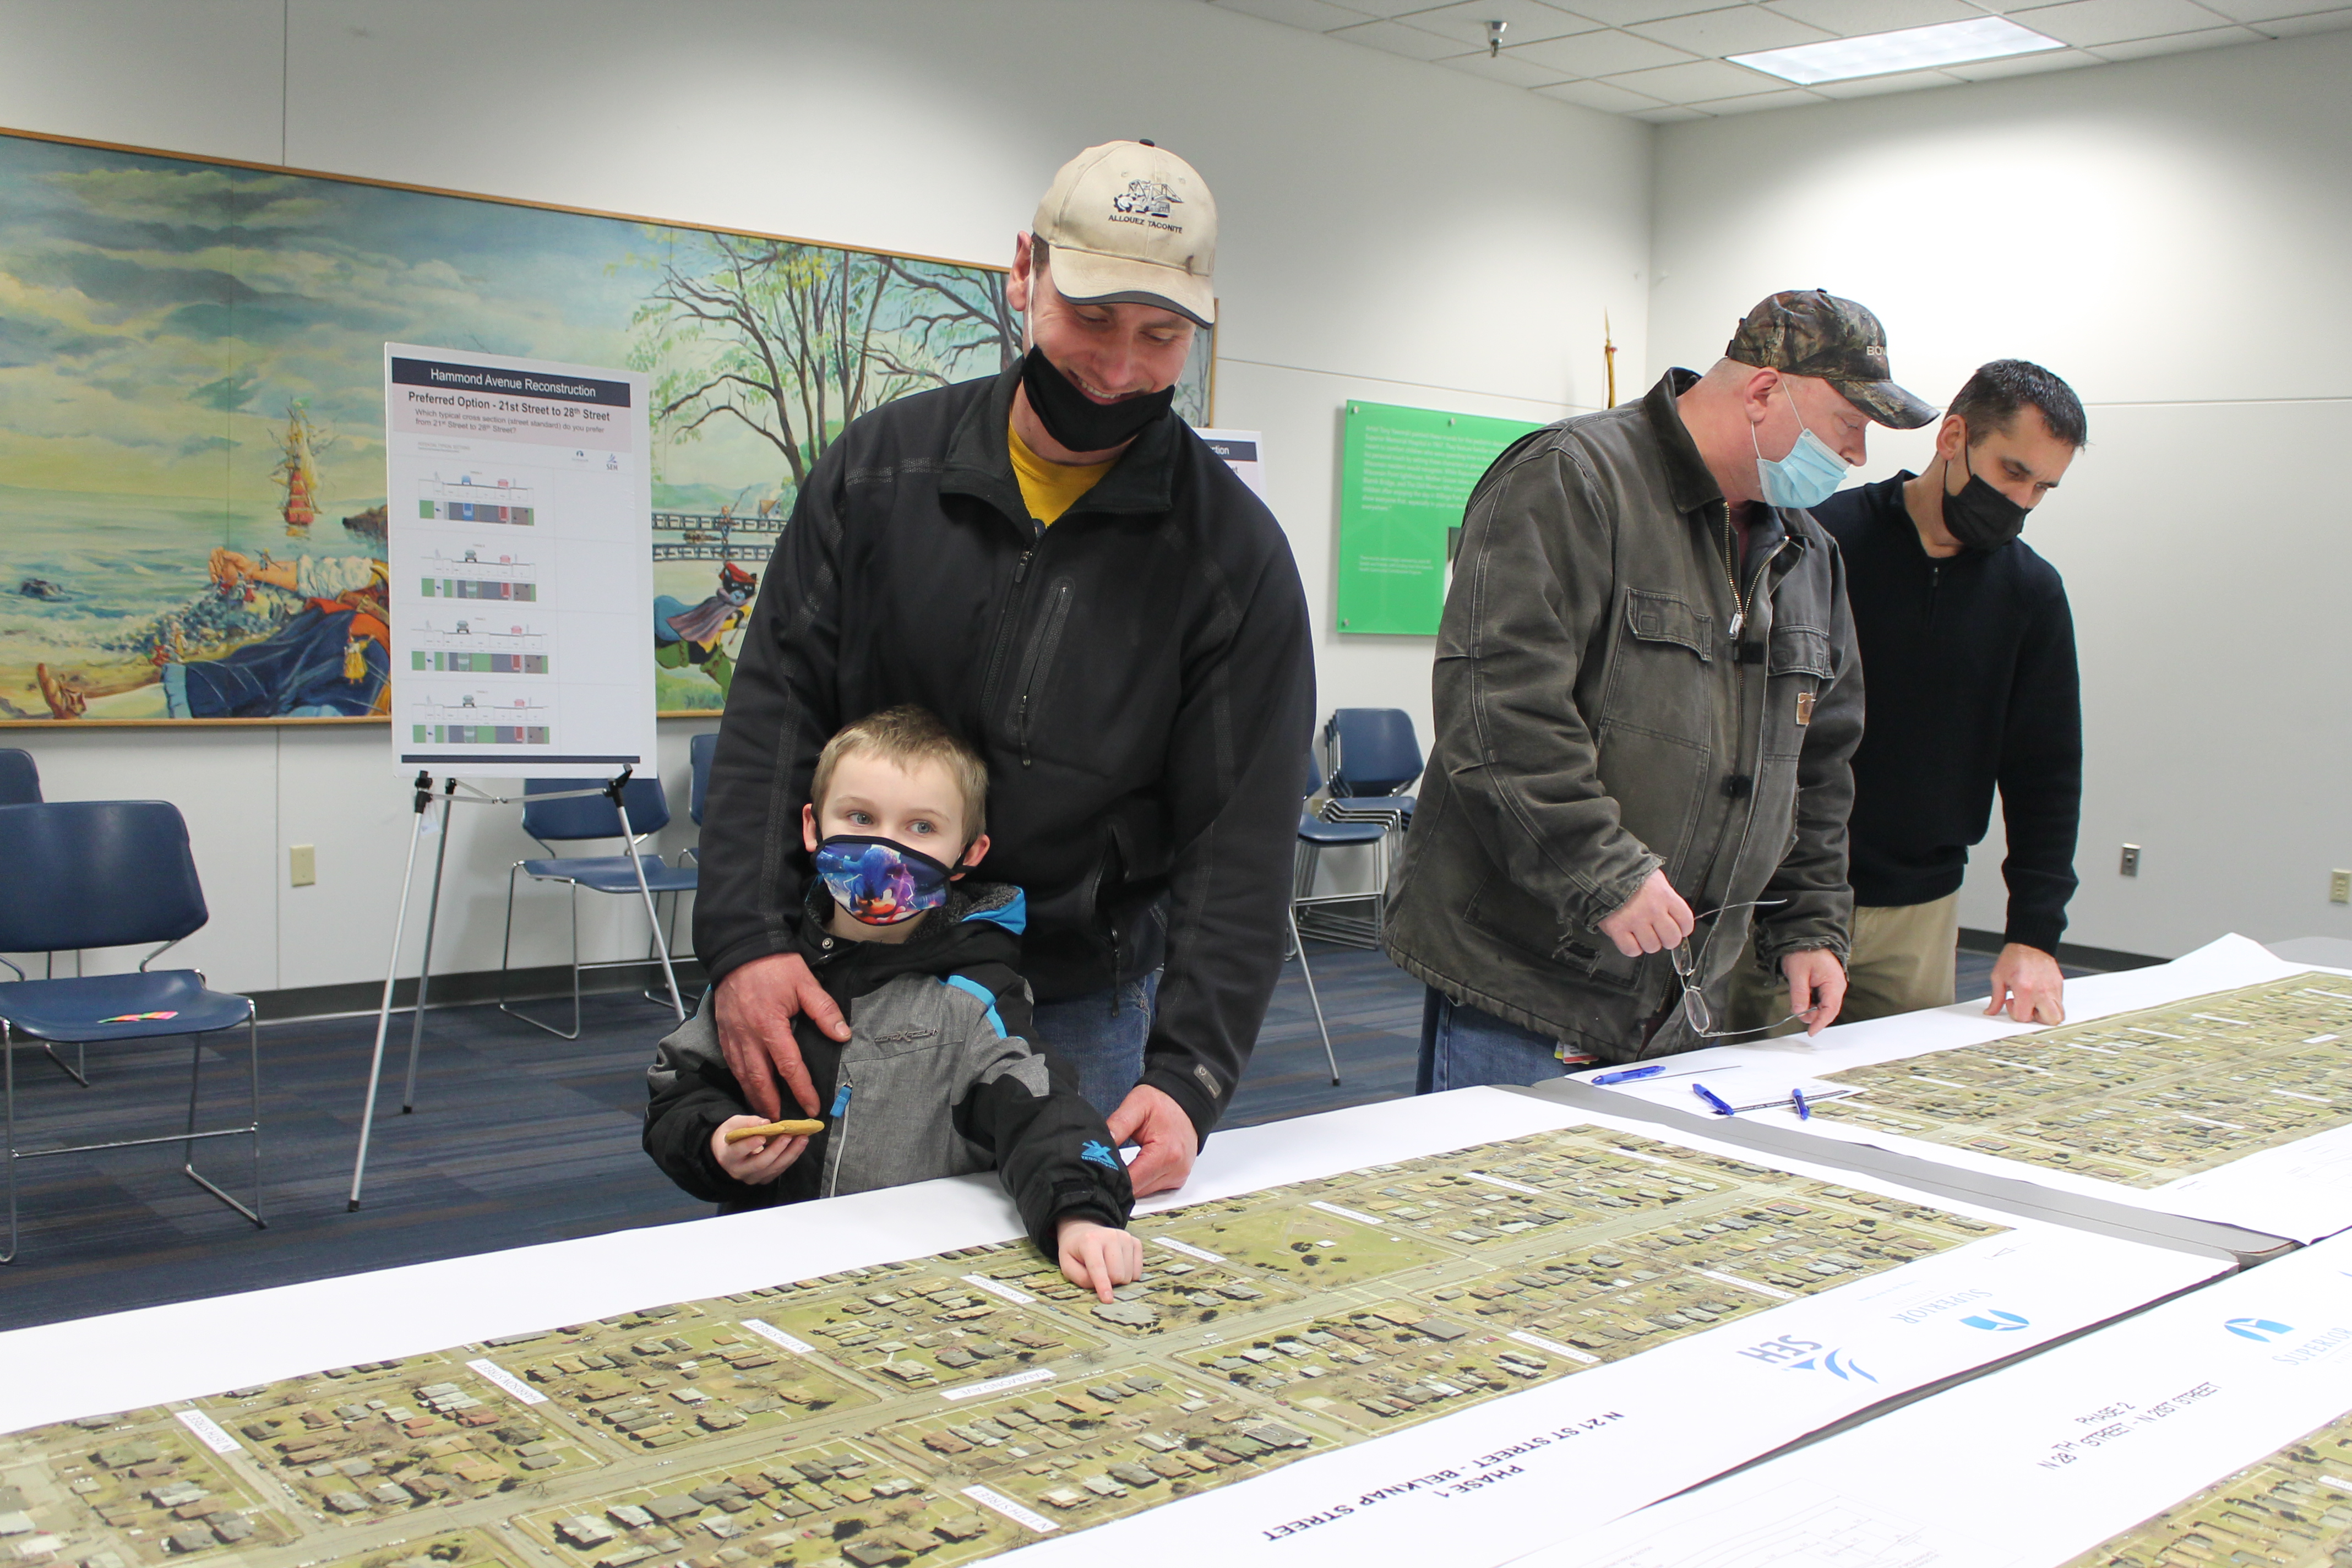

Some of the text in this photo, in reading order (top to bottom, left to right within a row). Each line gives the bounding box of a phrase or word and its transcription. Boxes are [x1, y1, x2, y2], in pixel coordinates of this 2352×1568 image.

[1108, 214, 1183, 233] ALLOUEZ TACONITE
[431, 368, 596, 397] Hammond Avenue Reconstruction
[409, 391, 454, 406] Preferred
[458, 396, 489, 409] Option
[499, 400, 519, 412] 21st
[521, 402, 549, 415] Street
[552, 407, 561, 416] to
[564, 407, 580, 417] 28th
[583, 409, 610, 421] Street
[415, 409, 437, 417] Which
[439, 411, 460, 420] typical
[482, 415, 505, 423] section
[508, 418, 529, 426] (street
[530, 420, 561, 430] standard)
[448, 421, 468, 429] Street
[492, 425, 516, 434] Street?
[1157, 1239, 1193, 1250] STREET
[967, 1277, 1002, 1289] STREET
[1712, 1274, 1754, 1286] STREET
[1890, 1289, 1992, 1324] SUPERIOR
[747, 1322, 782, 1337] STREET
[775, 1336, 802, 1347] 17TH
[1514, 1333, 1556, 1348] STREET
[1735, 1335, 1823, 1364] SEH
[2272, 1327, 2352, 1366] SUPERIOR
[1551, 1347, 1583, 1357] 19TH
[475, 1363, 542, 1402] HARRISON STREET
[959, 1371, 1049, 1395] HAMMOND AVE
[184, 1413, 215, 1431] STREET
[1602, 1412, 1625, 1420] N
[2074, 1402, 2136, 1425] PHASE 2
[2037, 1460, 2061, 1470] N
[2080, 1423, 2135, 1447] STREET
[2134, 1414, 2157, 1423] N
[2147, 1402, 2181, 1418] 21ST
[2172, 1382, 2222, 1404] STREET
[203, 1431, 228, 1445] 16TH
[1472, 1437, 1551, 1468] STREET
[1359, 1469, 1461, 1506] BELKNAP
[1448, 1464, 1525, 1494] PHASE
[968, 1489, 1015, 1510] STREET
[1006, 1508, 1042, 1524] 17TH
[1262, 1505, 1355, 1542] STREET
